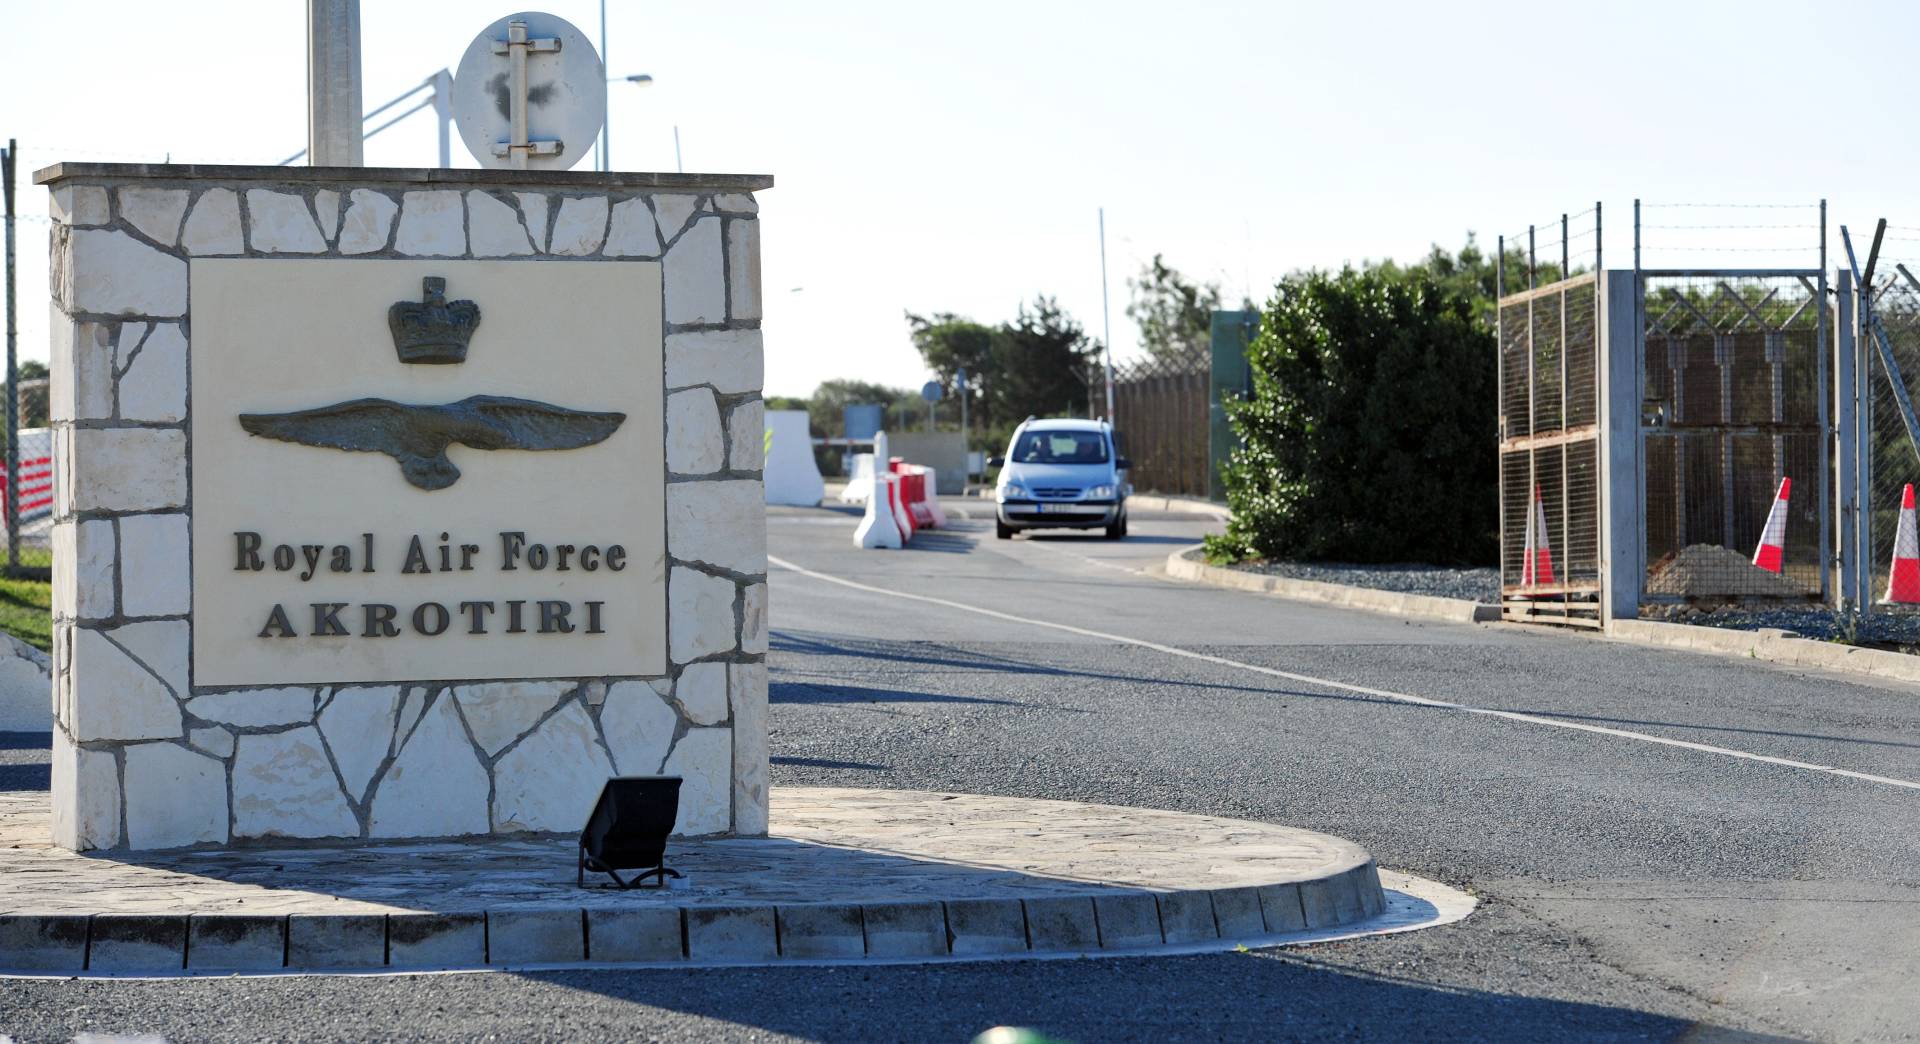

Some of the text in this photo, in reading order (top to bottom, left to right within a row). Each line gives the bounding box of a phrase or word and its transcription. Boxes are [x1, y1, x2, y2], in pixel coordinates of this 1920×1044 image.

[233, 531, 627, 581] Royal Air Force
[258, 600, 606, 638] AKROTIRI
